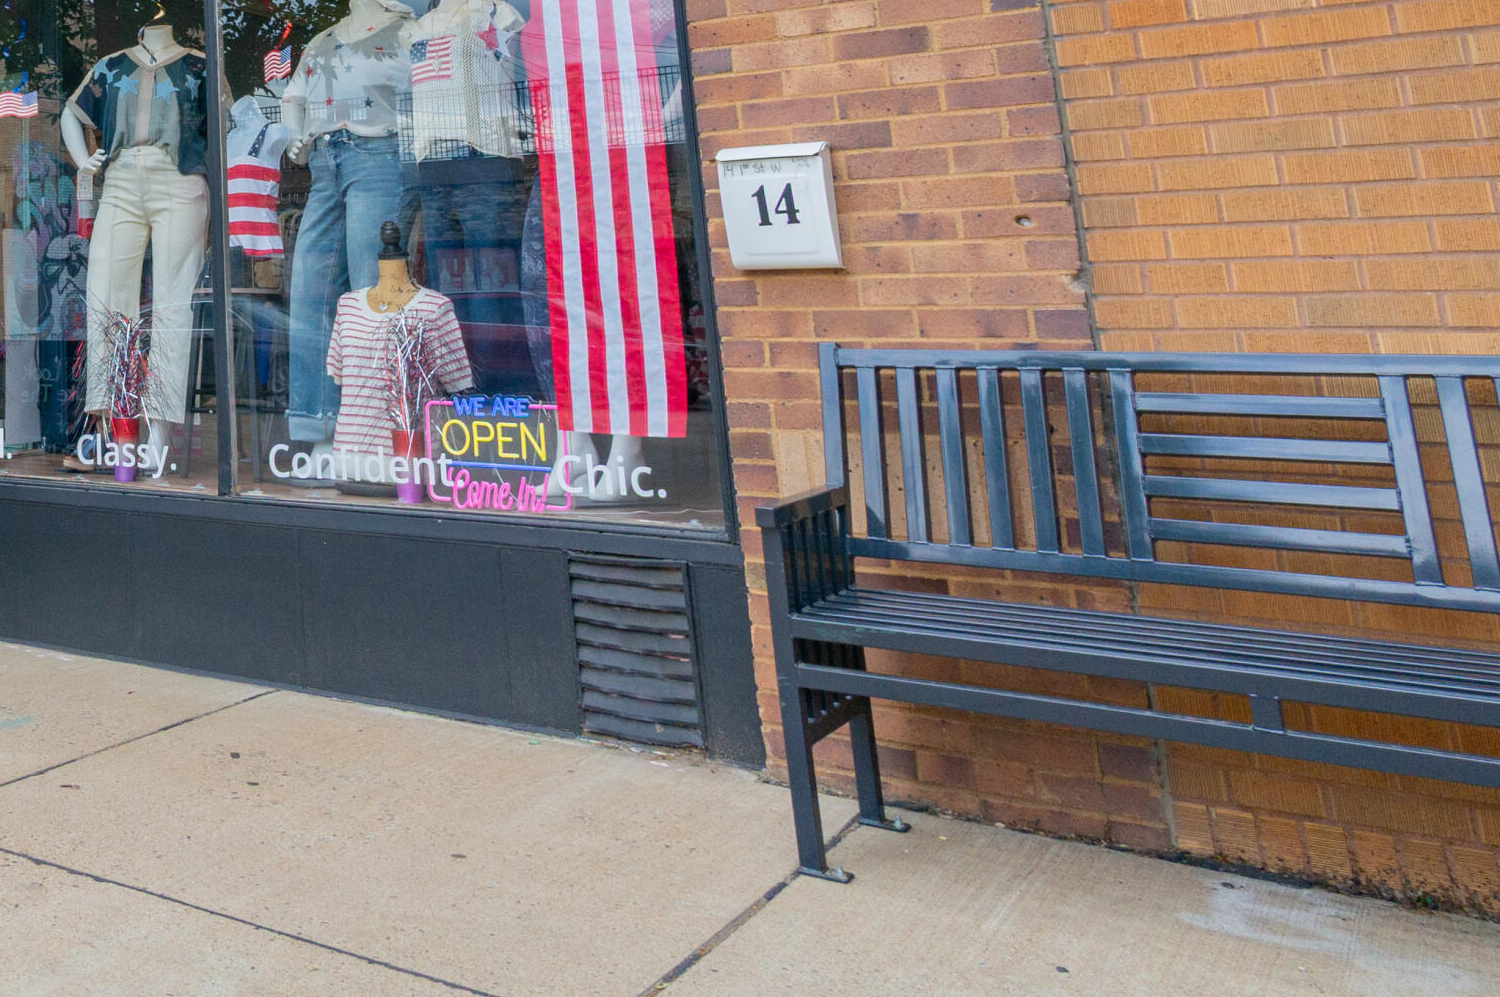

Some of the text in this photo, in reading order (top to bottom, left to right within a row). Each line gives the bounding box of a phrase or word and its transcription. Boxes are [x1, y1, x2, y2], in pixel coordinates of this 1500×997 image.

[751, 182, 801, 227] 14
[453, 395, 530, 418] WE ARE
[442, 419, 547, 462] OPEN
[77, 433, 177, 479] Classy.
[268, 443, 465, 487] Confident.
[556, 454, 668, 499] Chic.
[448, 467, 514, 510] Come
